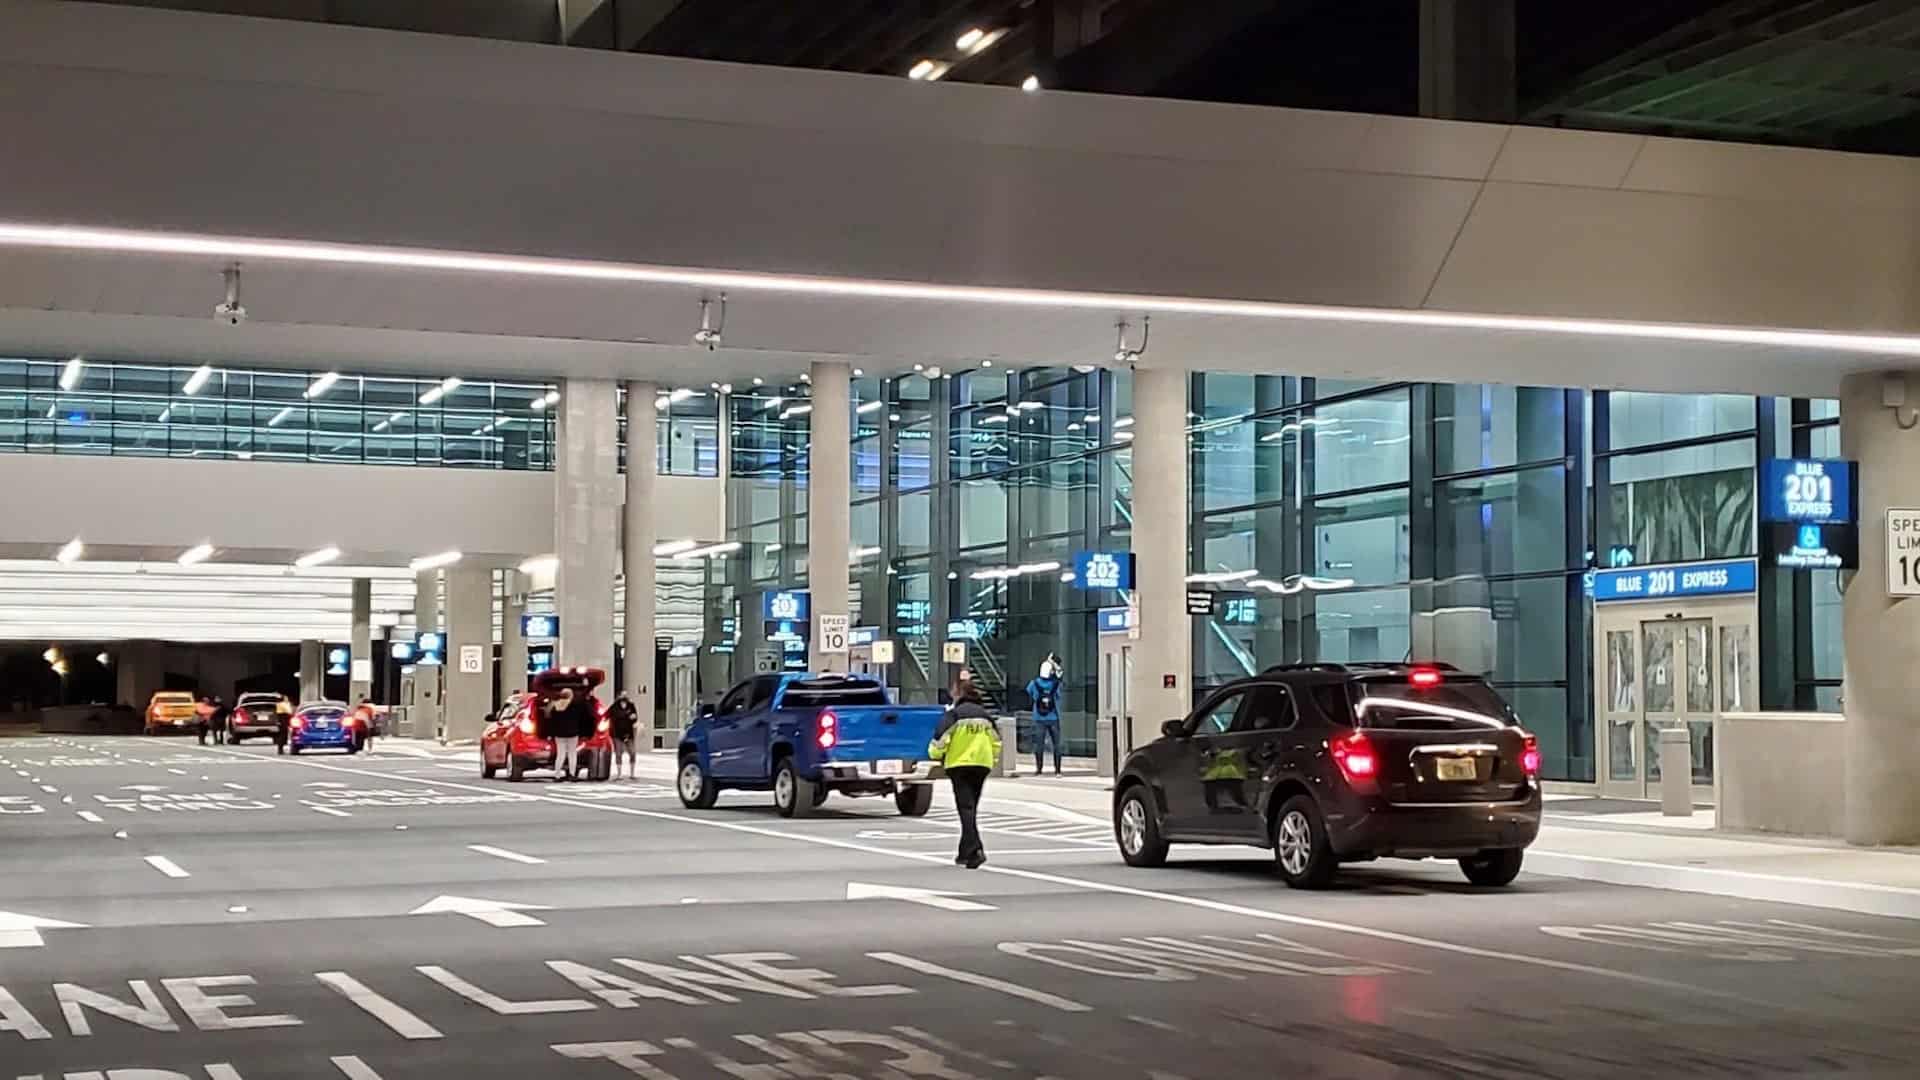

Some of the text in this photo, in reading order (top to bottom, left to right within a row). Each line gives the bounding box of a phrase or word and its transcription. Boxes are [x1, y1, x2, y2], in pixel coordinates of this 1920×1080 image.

[1795, 462, 1824, 476] BLUE
[1785, 474, 1832, 501] 201
[1787, 501, 1833, 516] EXPRESS
[1086, 561, 1120, 578] 202
[1616, 576, 1643, 593] BLUE
[1648, 570, 1675, 594] 201
[1682, 568, 1728, 589] EXPRESS
[825, 634, 844, 649] 10
[464, 660, 478, 670] 10
[415, 951, 920, 1015] LANE
